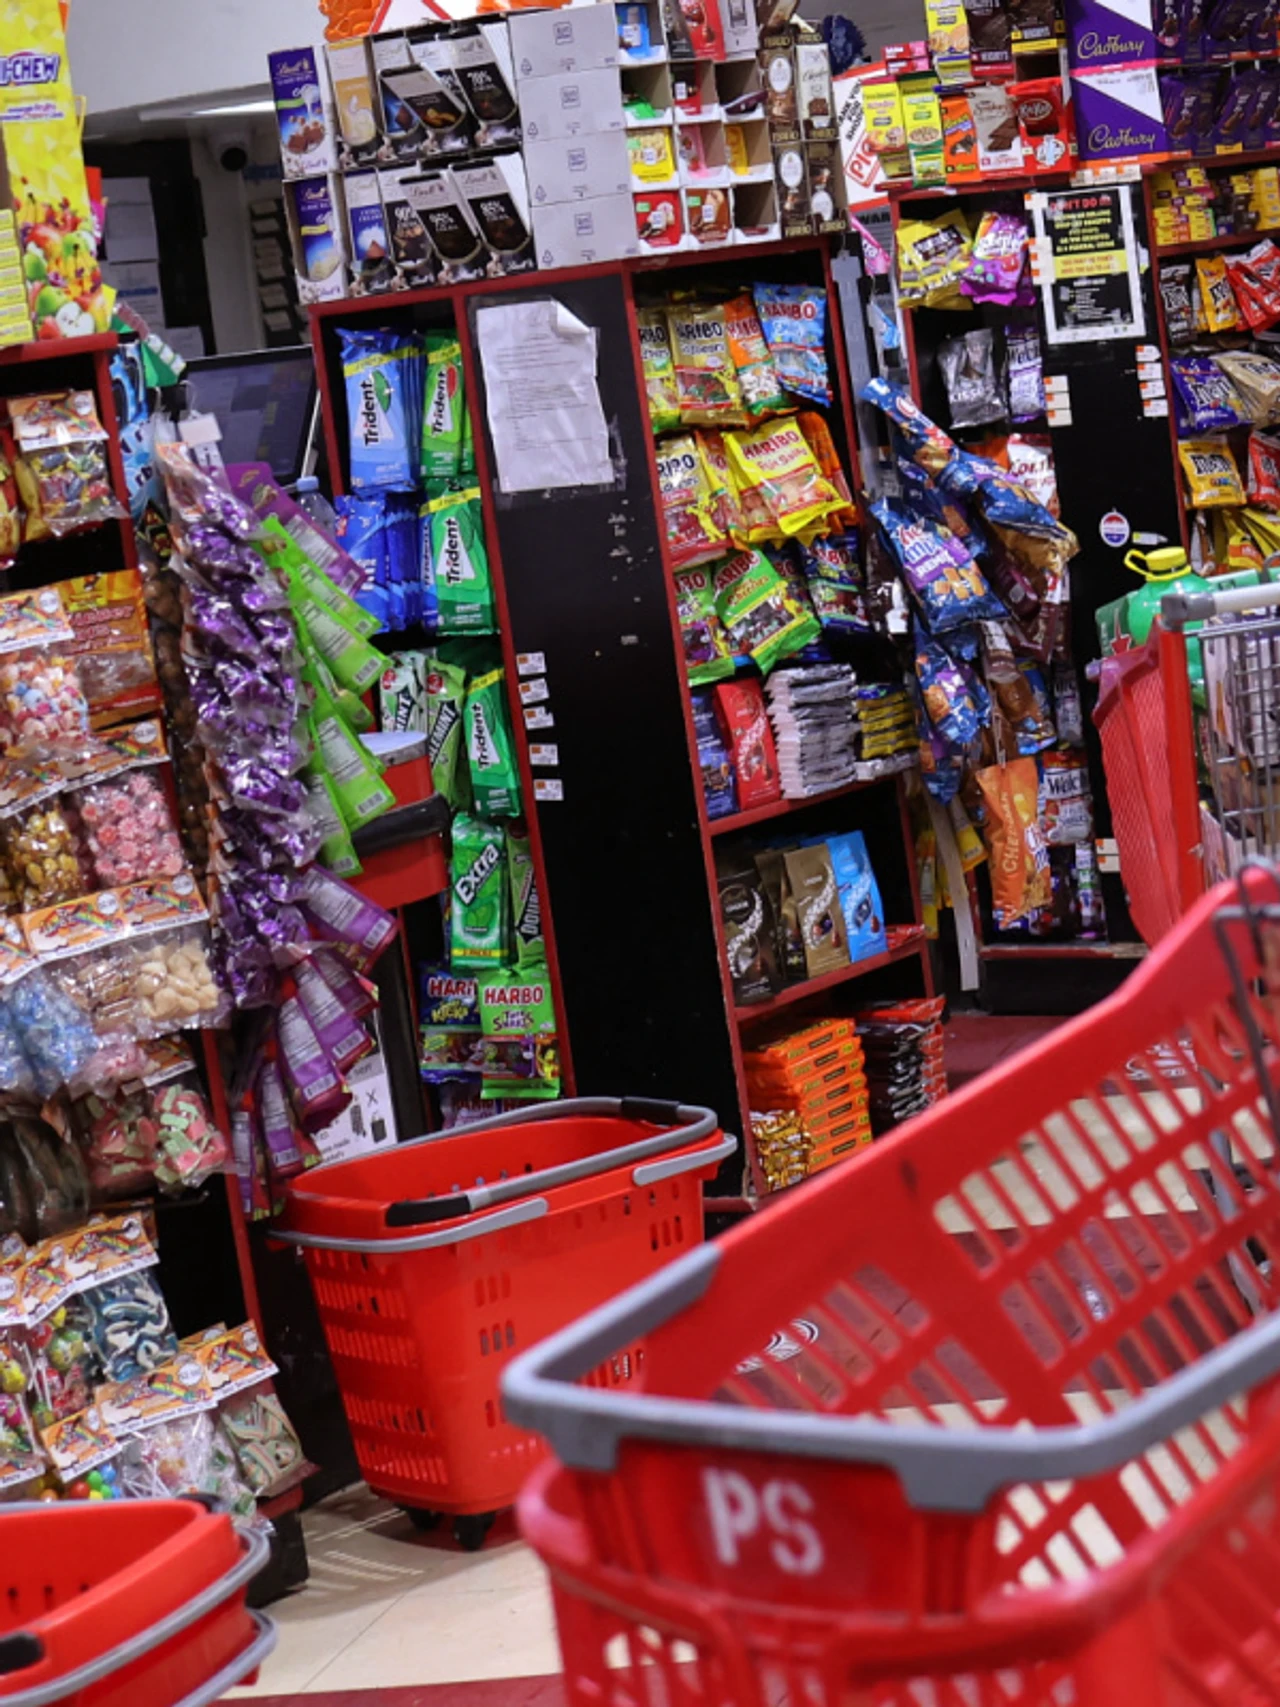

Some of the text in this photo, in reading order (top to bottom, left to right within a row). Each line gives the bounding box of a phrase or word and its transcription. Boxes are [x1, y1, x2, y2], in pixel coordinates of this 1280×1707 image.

[1076, 32, 1145, 60] Cadbury
[0, 55, 60, 84] I-CHEW
[1088, 123, 1156, 152] Cadbury
[360, 379, 379, 447] Trident
[431, 369, 448, 435] Trident
[741, 429, 801, 460] HARIBO
[657, 454, 696, 478] RIBO
[444, 517, 461, 585] Trident
[715, 550, 762, 592] ARIBO
[470, 701, 489, 769] Trident
[454, 843, 499, 906] Extra
[428, 976, 479, 998] HARI
[483, 984, 545, 1006] HARBO
